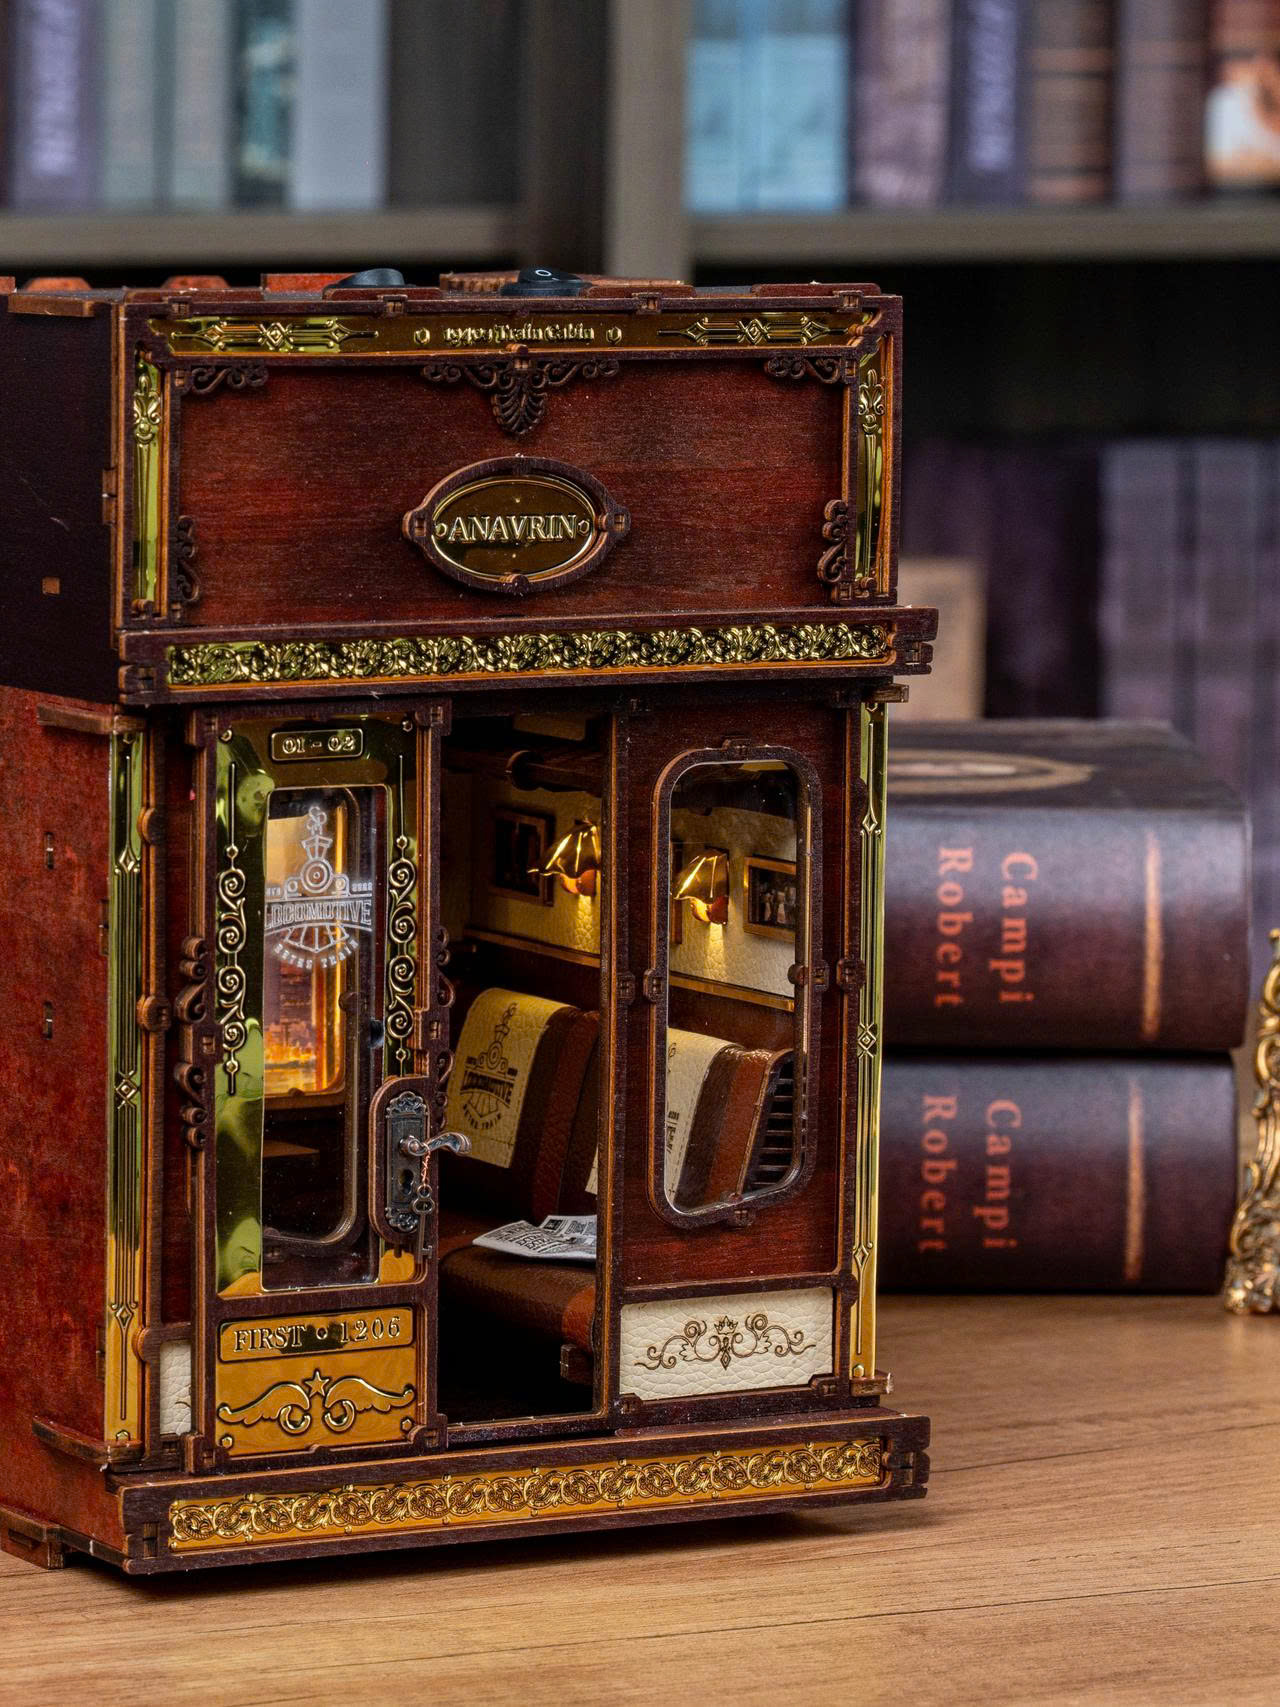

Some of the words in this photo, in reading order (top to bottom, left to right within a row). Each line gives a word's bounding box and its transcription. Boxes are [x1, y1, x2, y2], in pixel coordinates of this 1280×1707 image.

[448, 514, 578, 542] ANAVRIN
[264, 900, 373, 929] LOCOMOTIVE
[934, 846, 974, 1008] Robert
[989, 851, 1039, 1003] Campi
[917, 1094, 958, 1252] Robert
[973, 1098, 1023, 1250] Campi
[232, 1325, 307, 1353] FIRST
[339, 1315, 401, 1344] 1206
